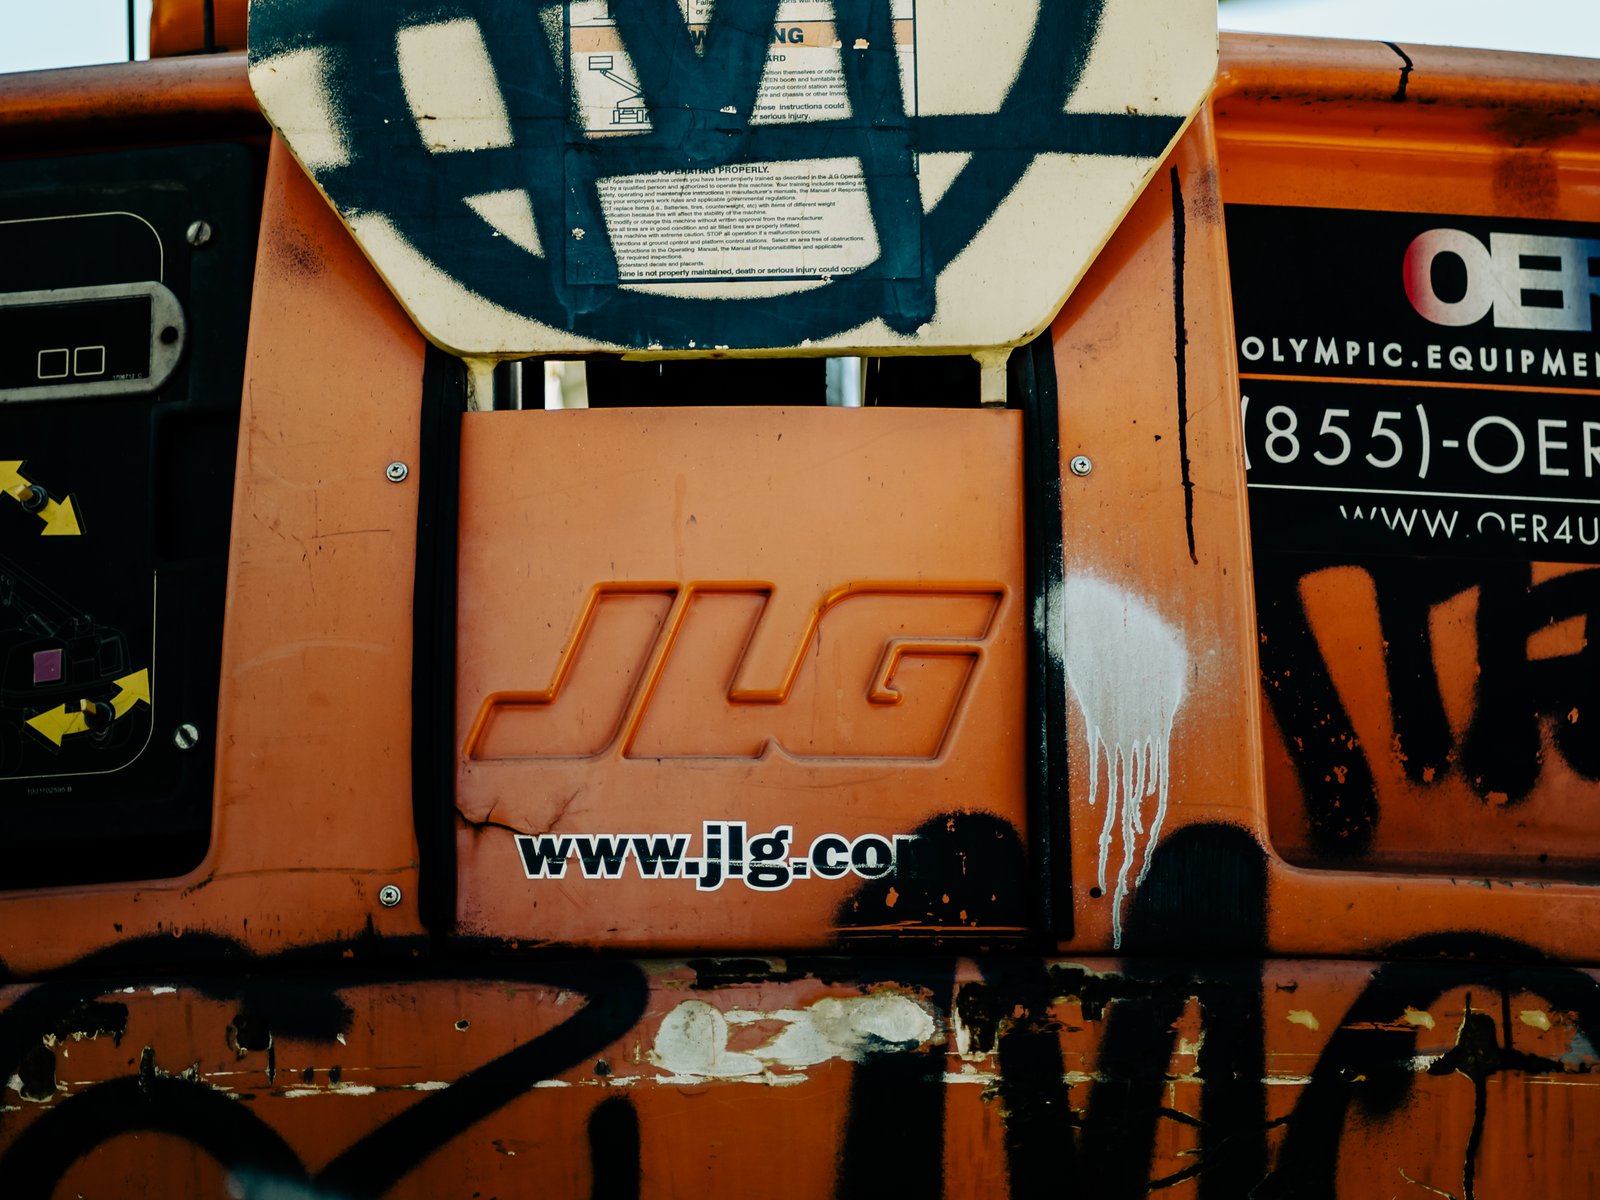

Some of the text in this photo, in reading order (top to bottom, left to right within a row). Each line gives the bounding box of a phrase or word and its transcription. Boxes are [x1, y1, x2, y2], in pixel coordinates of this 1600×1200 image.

[788, 113, 811, 121] injury.
[718, 166, 770, 174] PROPERLY.
[623, 184, 646, 192] qualified
[716, 182, 737, 190] operate
[697, 196, 726, 204] applicable
[727, 195, 764, 203] governmental
[613, 218, 632, 226] modify
[648, 239, 669, 247] ground
[698, 245, 719, 253] Manual,
[815, 243, 843, 251] applicable
[659, 269, 690, 277] properly
[691, 268, 734, 277] maintained,
[767, 266, 794, 274] serious
[796, 266, 817, 275] injury
[818, 265, 839, 273] could
[1241, 336, 1600, 378] OLYMPIC.EQUIPME
[464, 580, 1008, 766] JLG
[514, 821, 924, 891] www.jlg.co
